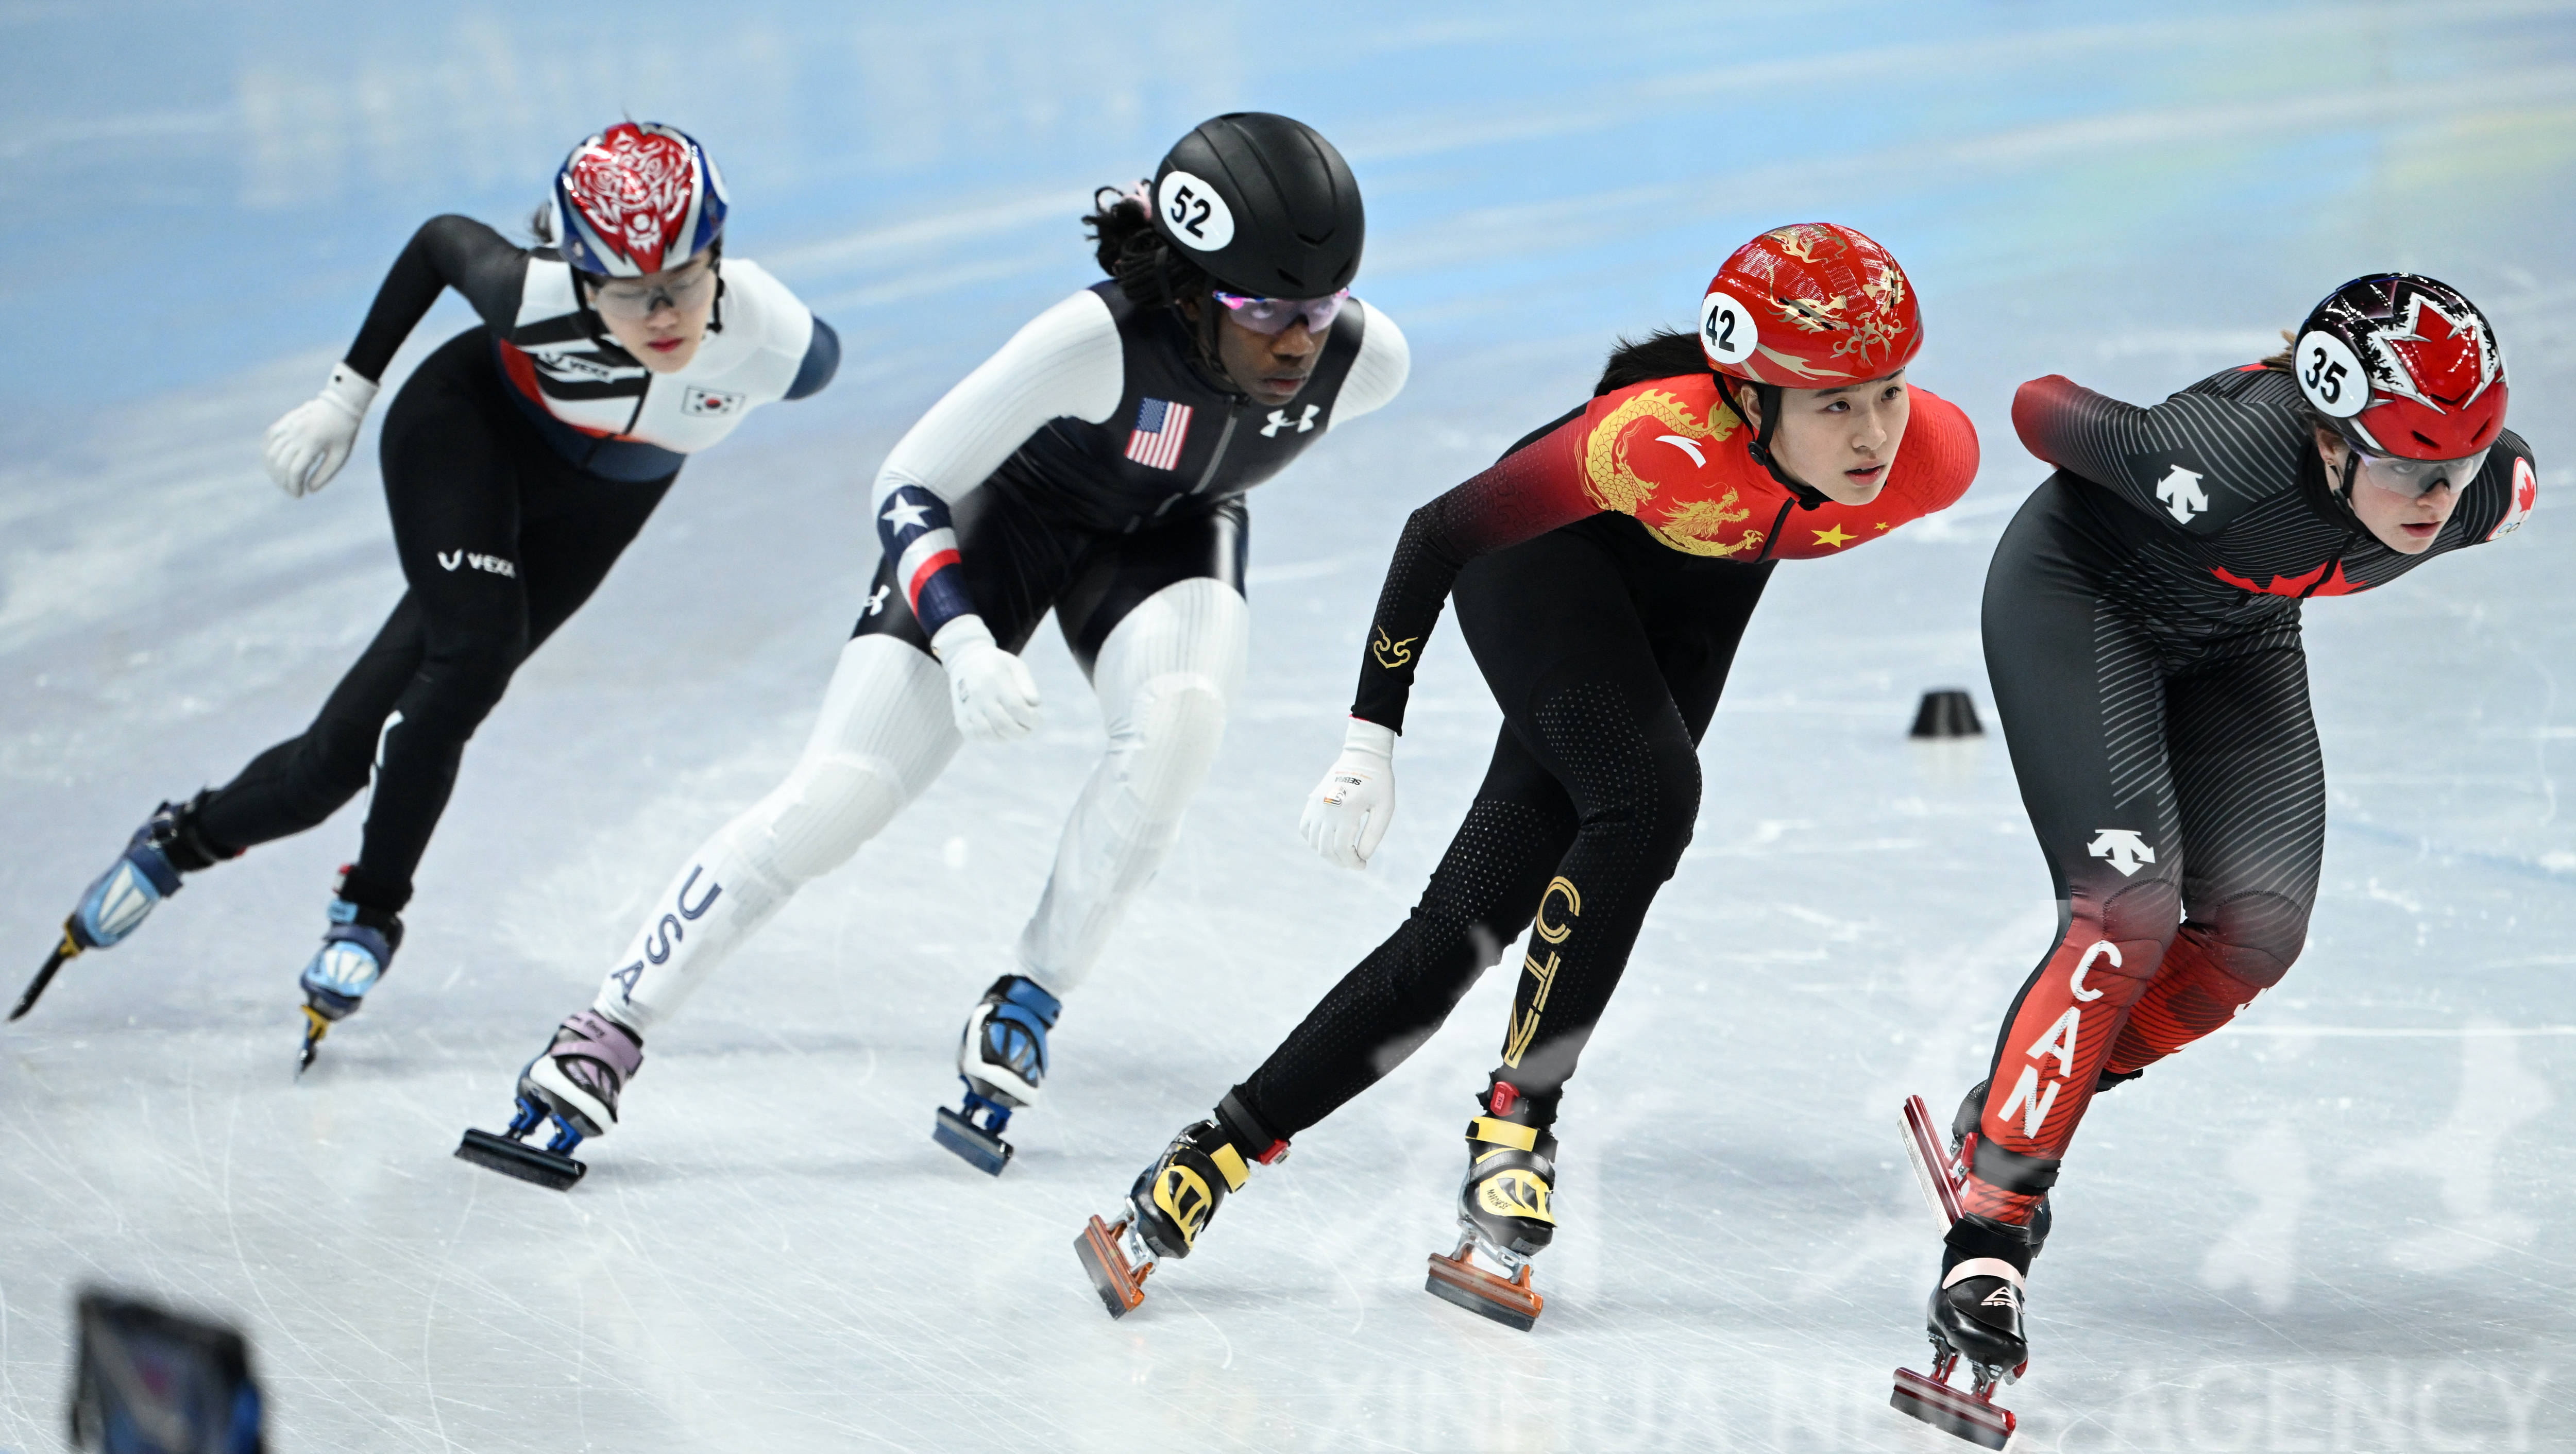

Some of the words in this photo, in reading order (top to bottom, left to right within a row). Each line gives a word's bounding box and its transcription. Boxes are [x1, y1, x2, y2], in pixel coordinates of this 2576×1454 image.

[1171, 185, 1211, 239] 52
[1706, 305, 1735, 352] 42
[2306, 347, 2348, 404] 35
[612, 864, 722, 1005] USA
[1997, 940, 2122, 1139] CAN
